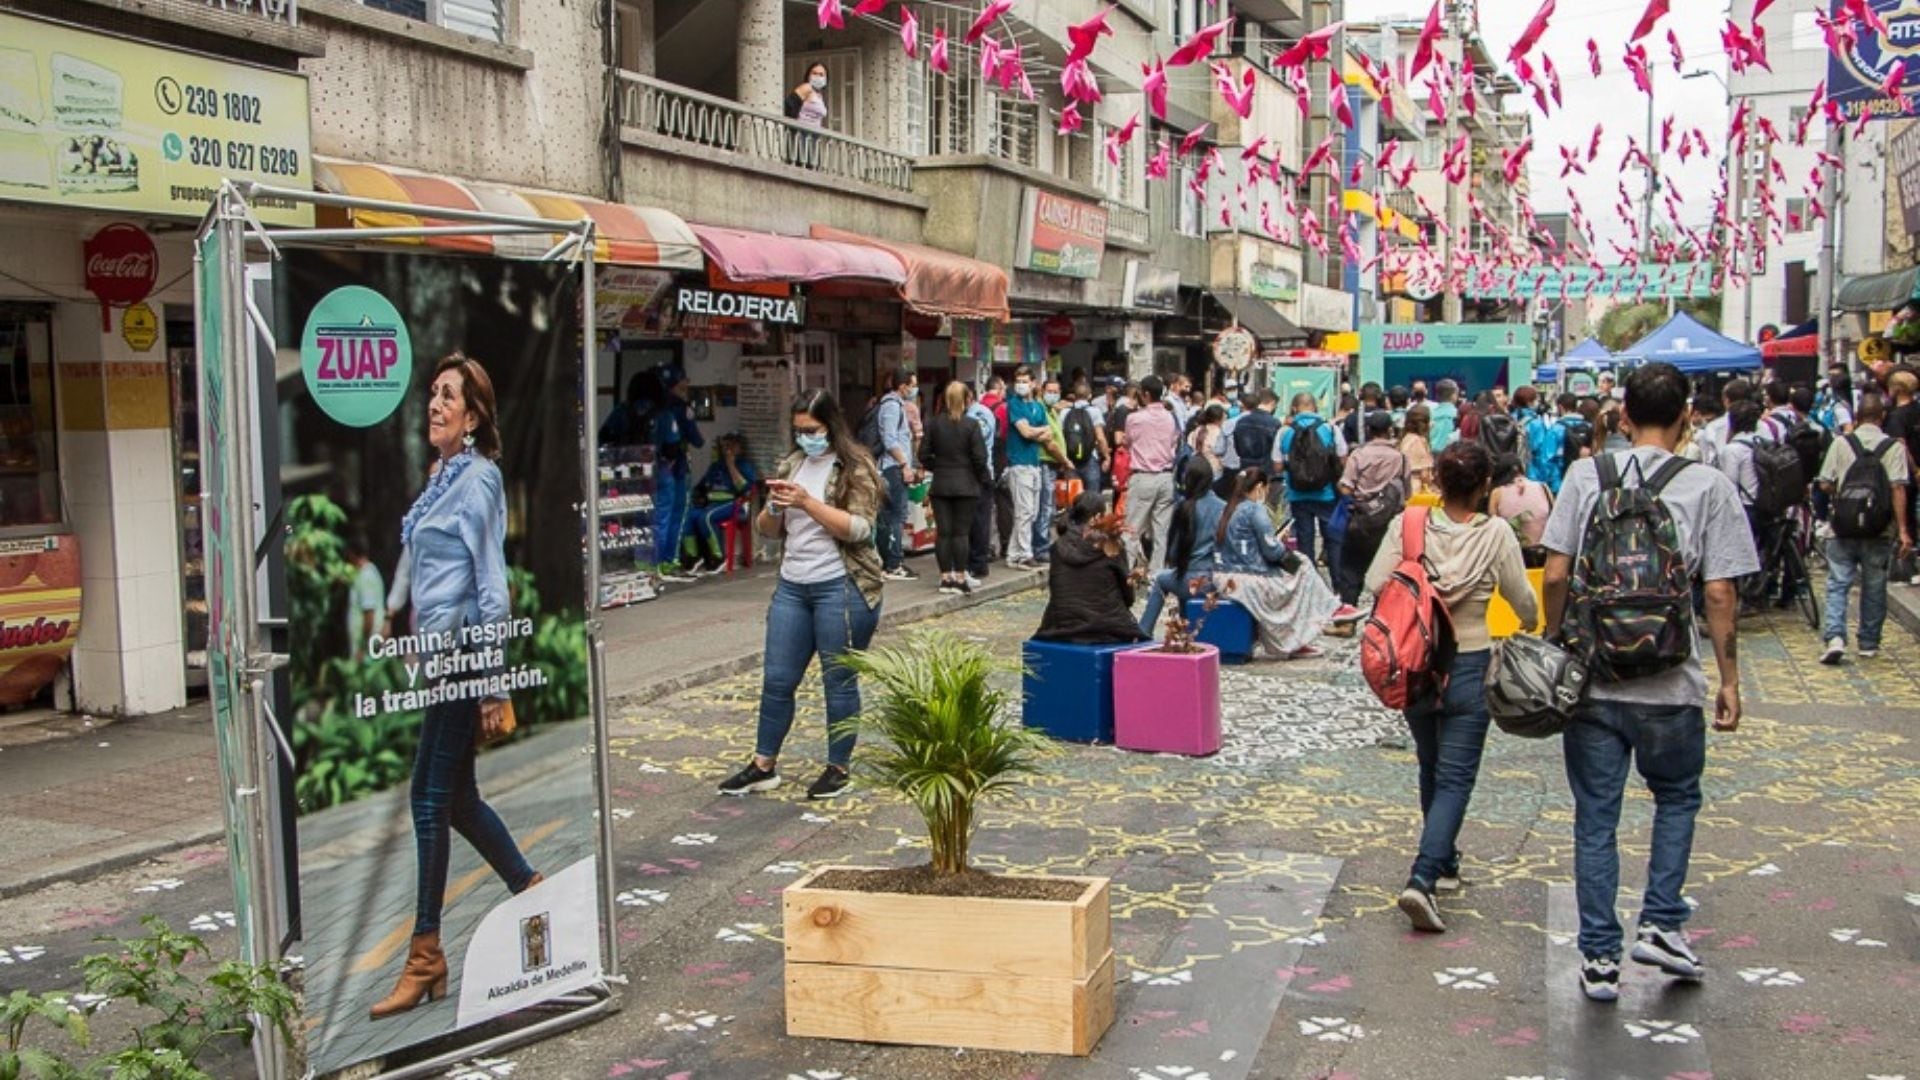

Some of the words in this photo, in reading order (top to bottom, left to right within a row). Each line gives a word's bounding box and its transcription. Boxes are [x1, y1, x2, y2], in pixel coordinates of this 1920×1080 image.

[185, 85, 218, 117] 239
[223, 92, 262, 124] 1802
[189, 135, 222, 167] 320
[227, 141, 254, 171] 627
[260, 145, 299, 177] 6289
[677, 288, 799, 324] RELOJERIA
[316, 338, 398, 380] ZUAP
[1383, 332, 1425, 349] ZUAP
[368, 627, 457, 659] Camina,
[461, 615, 533, 646] respira
[404, 661, 420, 688] y
[425, 646, 504, 679] disfruta
[355, 693, 376, 718] la
[382, 664, 548, 713] transformación.
[530, 974, 543, 987] de
